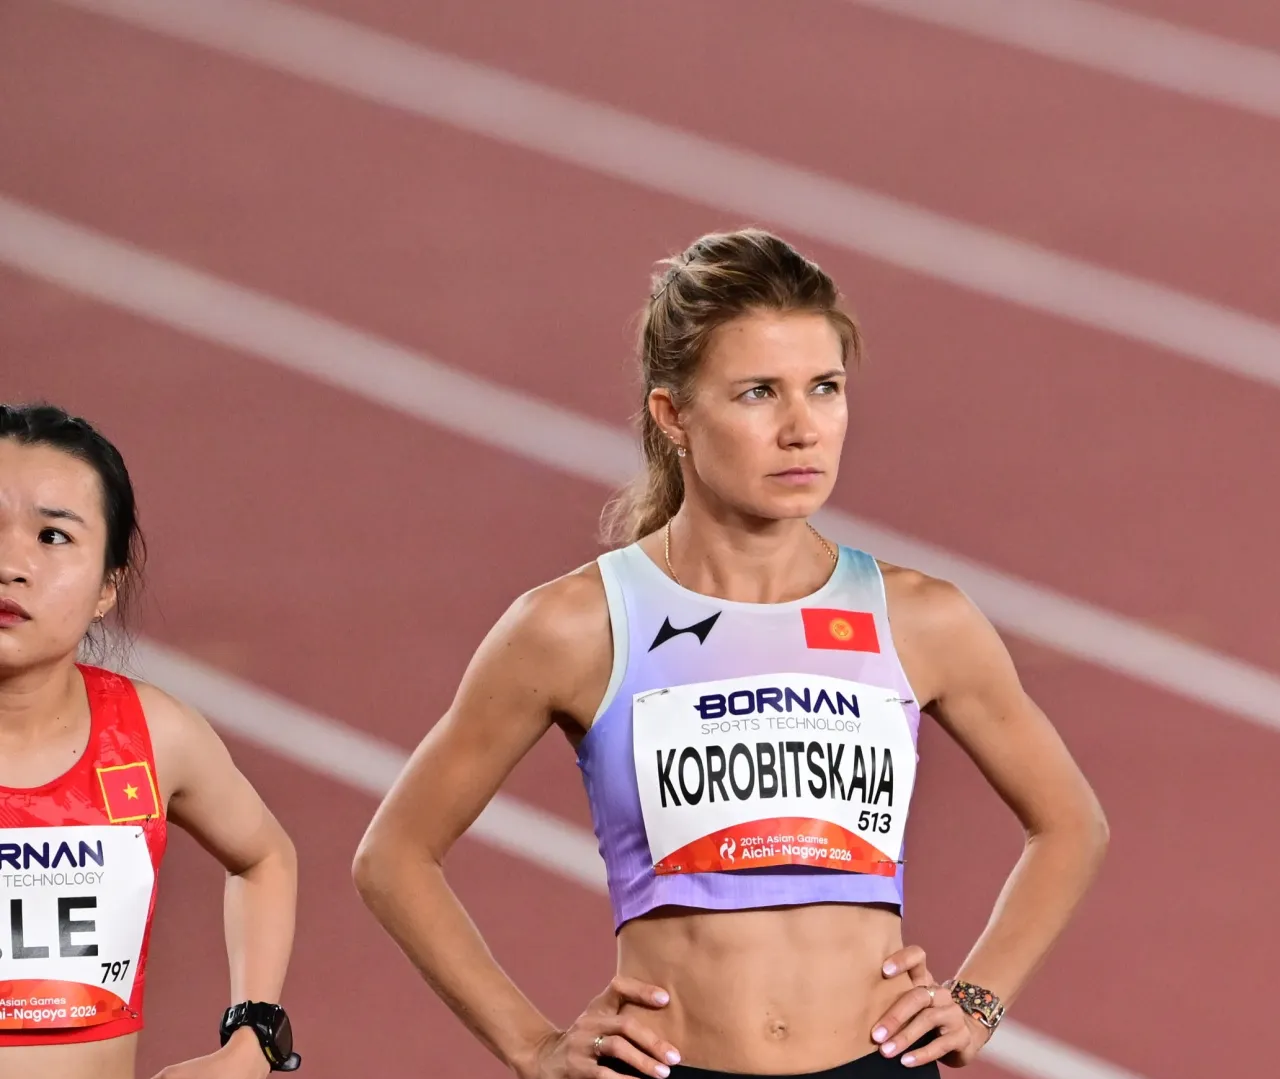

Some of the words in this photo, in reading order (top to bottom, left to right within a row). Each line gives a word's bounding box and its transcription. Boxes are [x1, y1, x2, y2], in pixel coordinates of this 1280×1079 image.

[694, 687, 861, 720] BORNAN
[701, 719, 760, 735] SPORTS
[769, 717, 861, 733] TECHNOLOGY
[656, 741, 894, 808] KOROBITSKAIA
[857, 811, 892, 835] 513
[740, 837, 765, 847] 20th
[767, 835, 795, 845] Asian
[798, 834, 828, 846] Games
[742, 844, 827, 861] Aichi-Nagoya
[829, 847, 852, 862] 2026
[3, 872, 104, 887] TECHNOLOGY
[100, 960, 130, 983] 797
[30, 997, 66, 1006] Games
[70, 1005, 96, 1018] 2026
